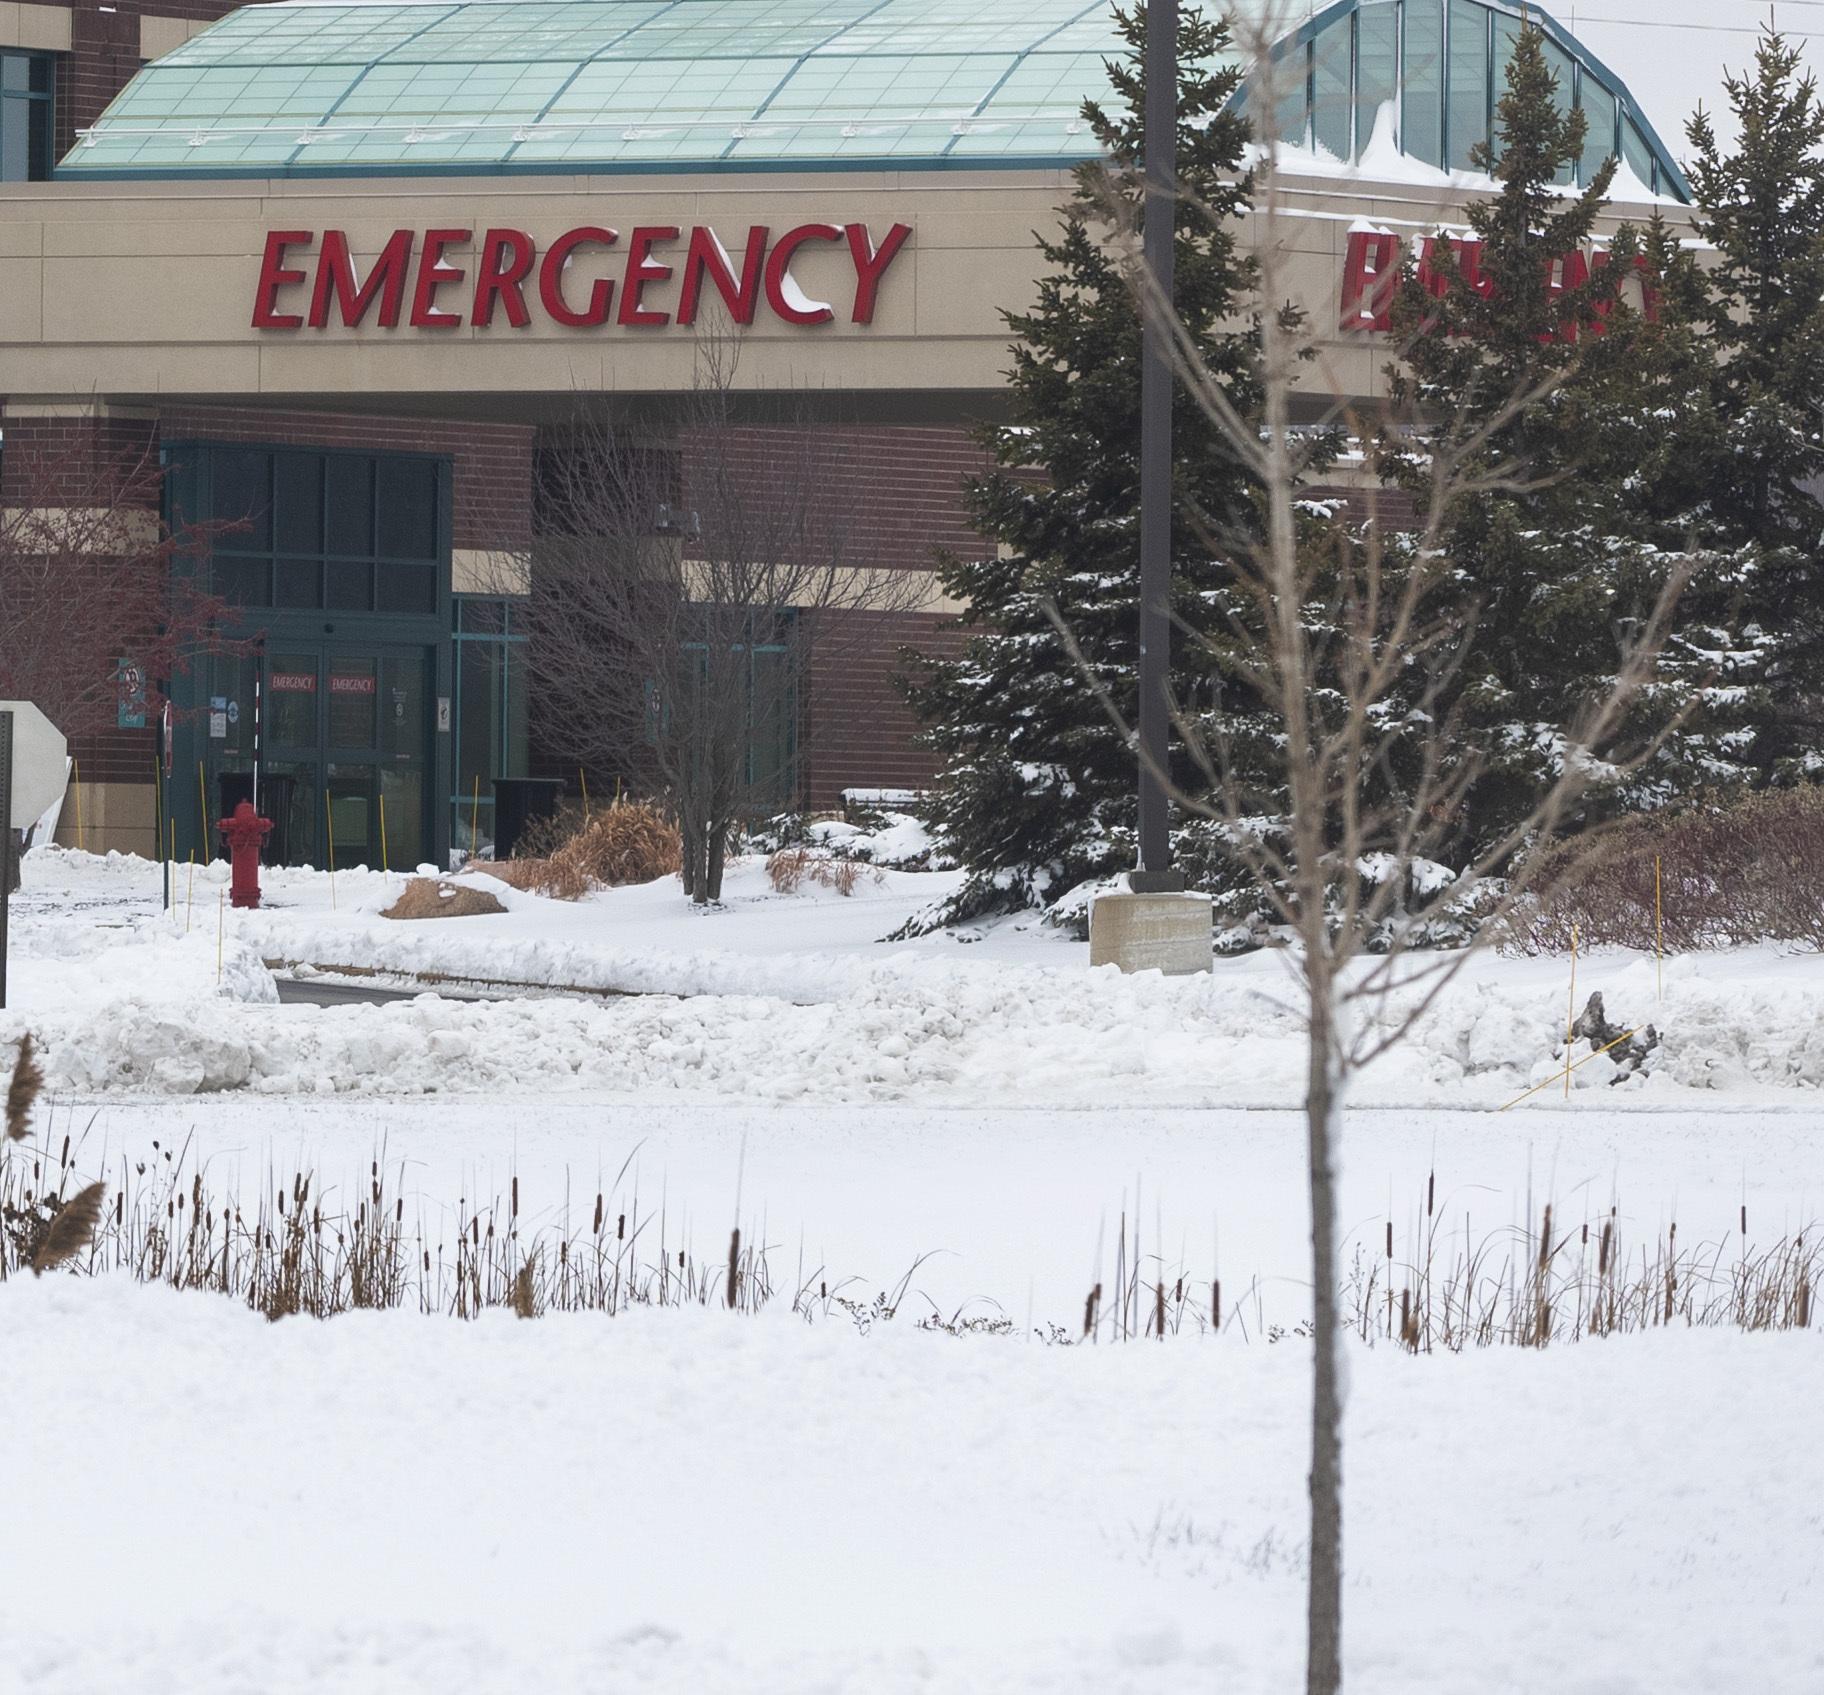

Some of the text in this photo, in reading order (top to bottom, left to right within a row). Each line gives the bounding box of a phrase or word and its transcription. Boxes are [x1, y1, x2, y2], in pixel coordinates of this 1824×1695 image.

[251, 223, 913, 328] EMERGENCY
[272, 676, 312, 689] EMERGENCY
[332, 678, 372, 691] EMERGENCY
